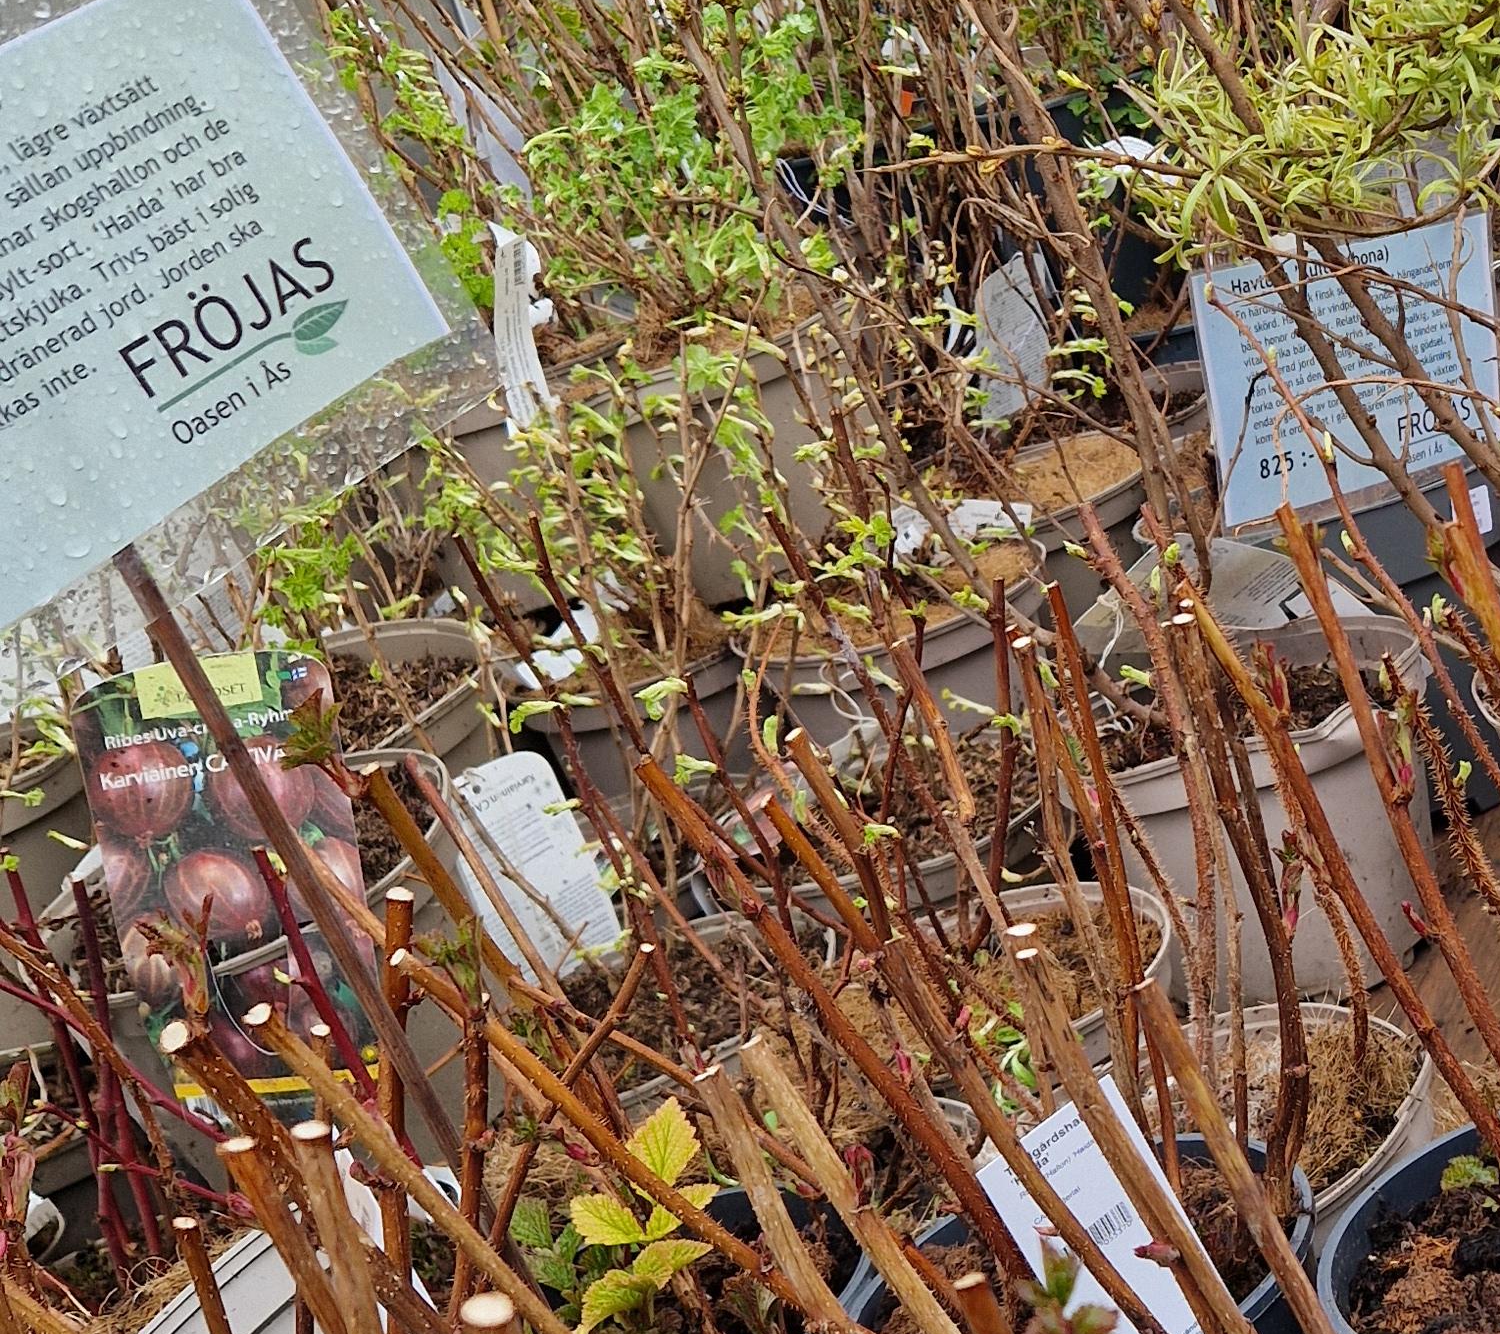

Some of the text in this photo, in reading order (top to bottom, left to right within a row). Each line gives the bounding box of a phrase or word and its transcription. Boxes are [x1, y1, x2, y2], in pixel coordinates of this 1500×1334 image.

[4, 94, 207, 209] sällan uppbindning.
[8, 75, 160, 162] lägre växtsätt
[40, 117, 230, 232] skogshallon och de
[92, 187, 165, 239] ‘Haida’
[171, 170, 207, 199] har
[208, 149, 248, 178] bra
[91, 246, 149, 282] Trivs
[148, 217, 196, 253] bäst
[195, 207, 209, 225] i
[209, 183, 260, 218] solig
[99, 283, 154, 329] jord.
[160, 240, 228, 290] Jorden
[229, 220, 264, 248] ska
[118, 237, 335, 398] FRÖJAS
[1253, 316, 1279, 333] skörd.
[42, 363, 97, 398] inte.
[172, 360, 291, 445] Oasen i Ås
[1258, 449, 1294, 479] 825
[100, 760, 201, 791] Karviainen
[104, 731, 152, 751] Ribes
